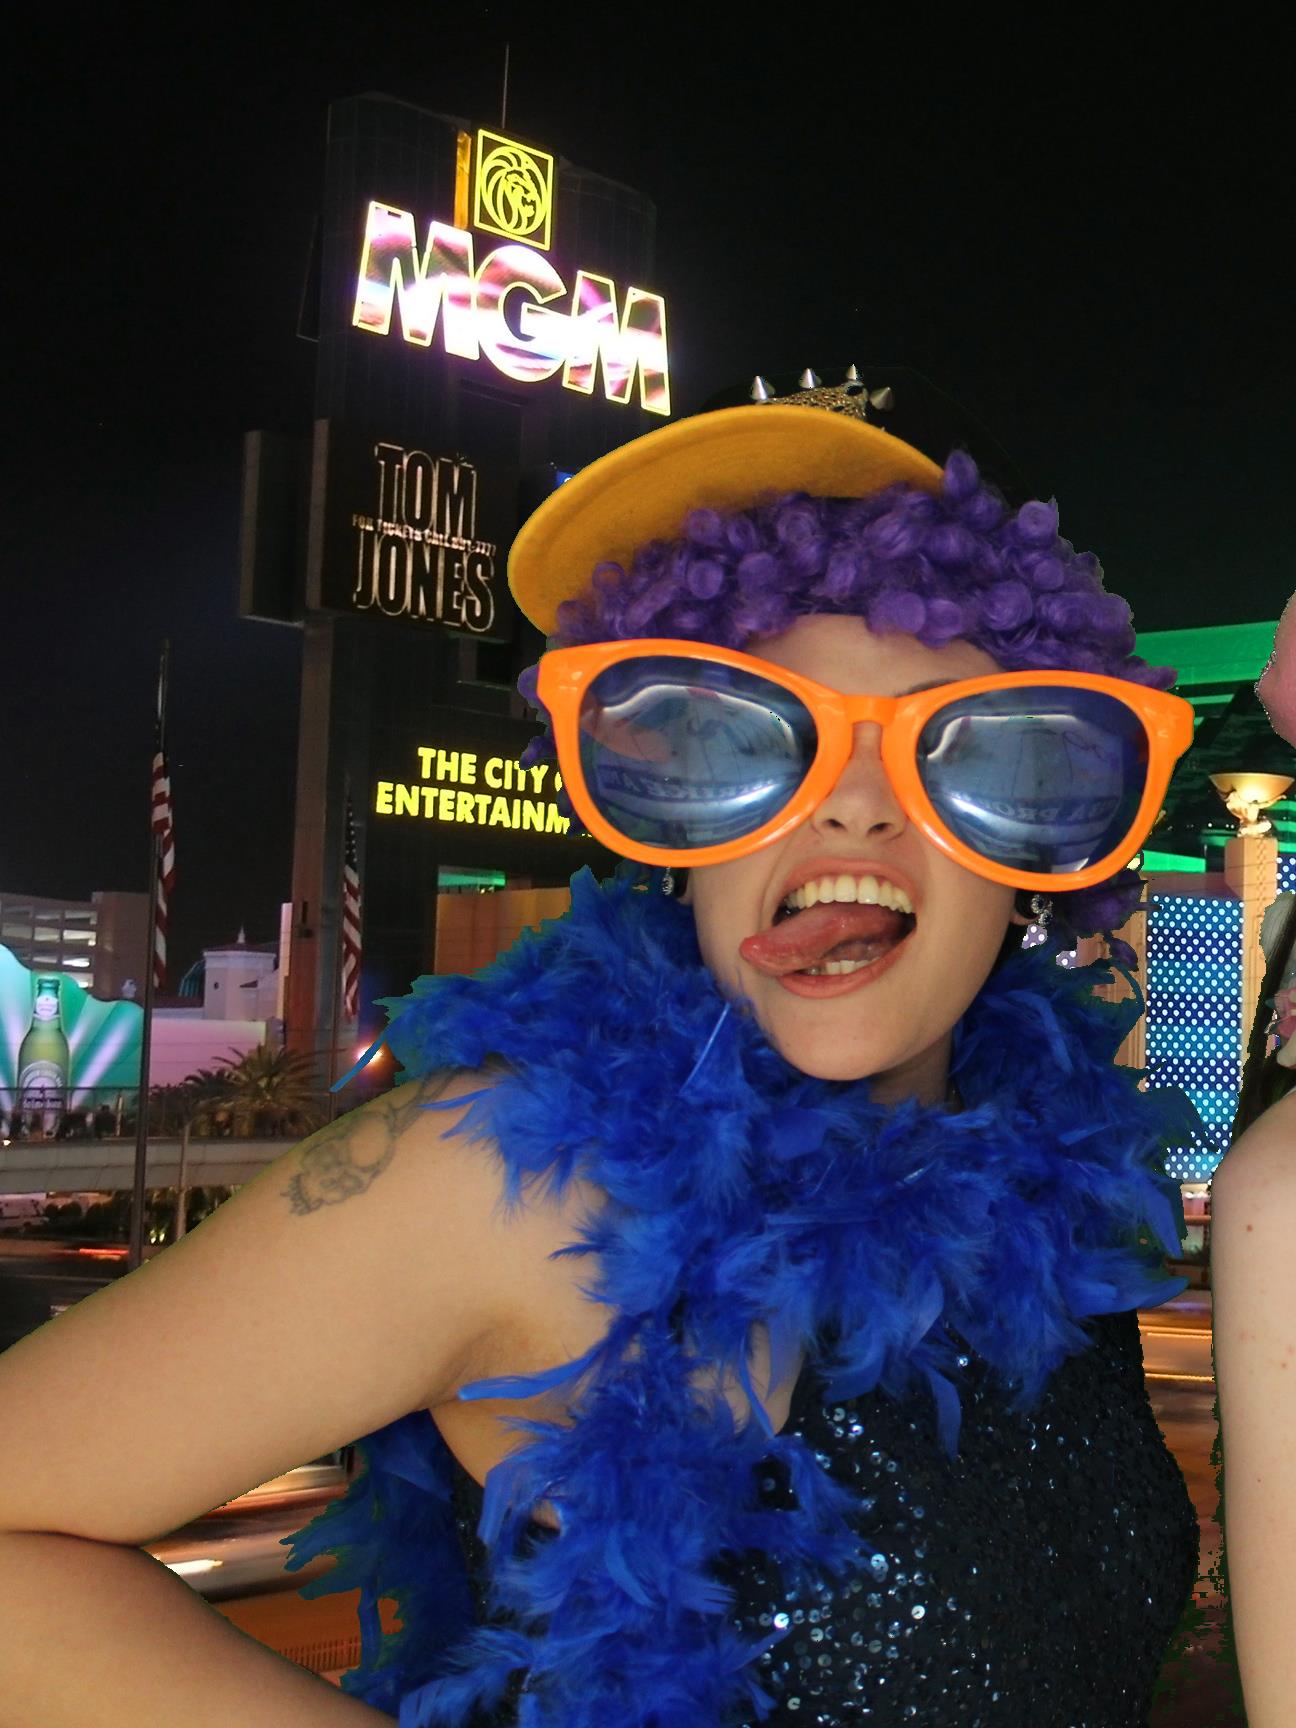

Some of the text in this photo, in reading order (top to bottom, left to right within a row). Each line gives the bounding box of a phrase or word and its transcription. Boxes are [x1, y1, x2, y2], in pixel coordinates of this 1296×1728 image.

[352, 201, 671, 417] MGM
[374, 442, 479, 539] TOM
[352, 530, 497, 634] JONES
[375, 781, 571, 835] ENTERTAINM
[417, 746, 477, 785] THE
[484, 756, 549, 794] CITY
